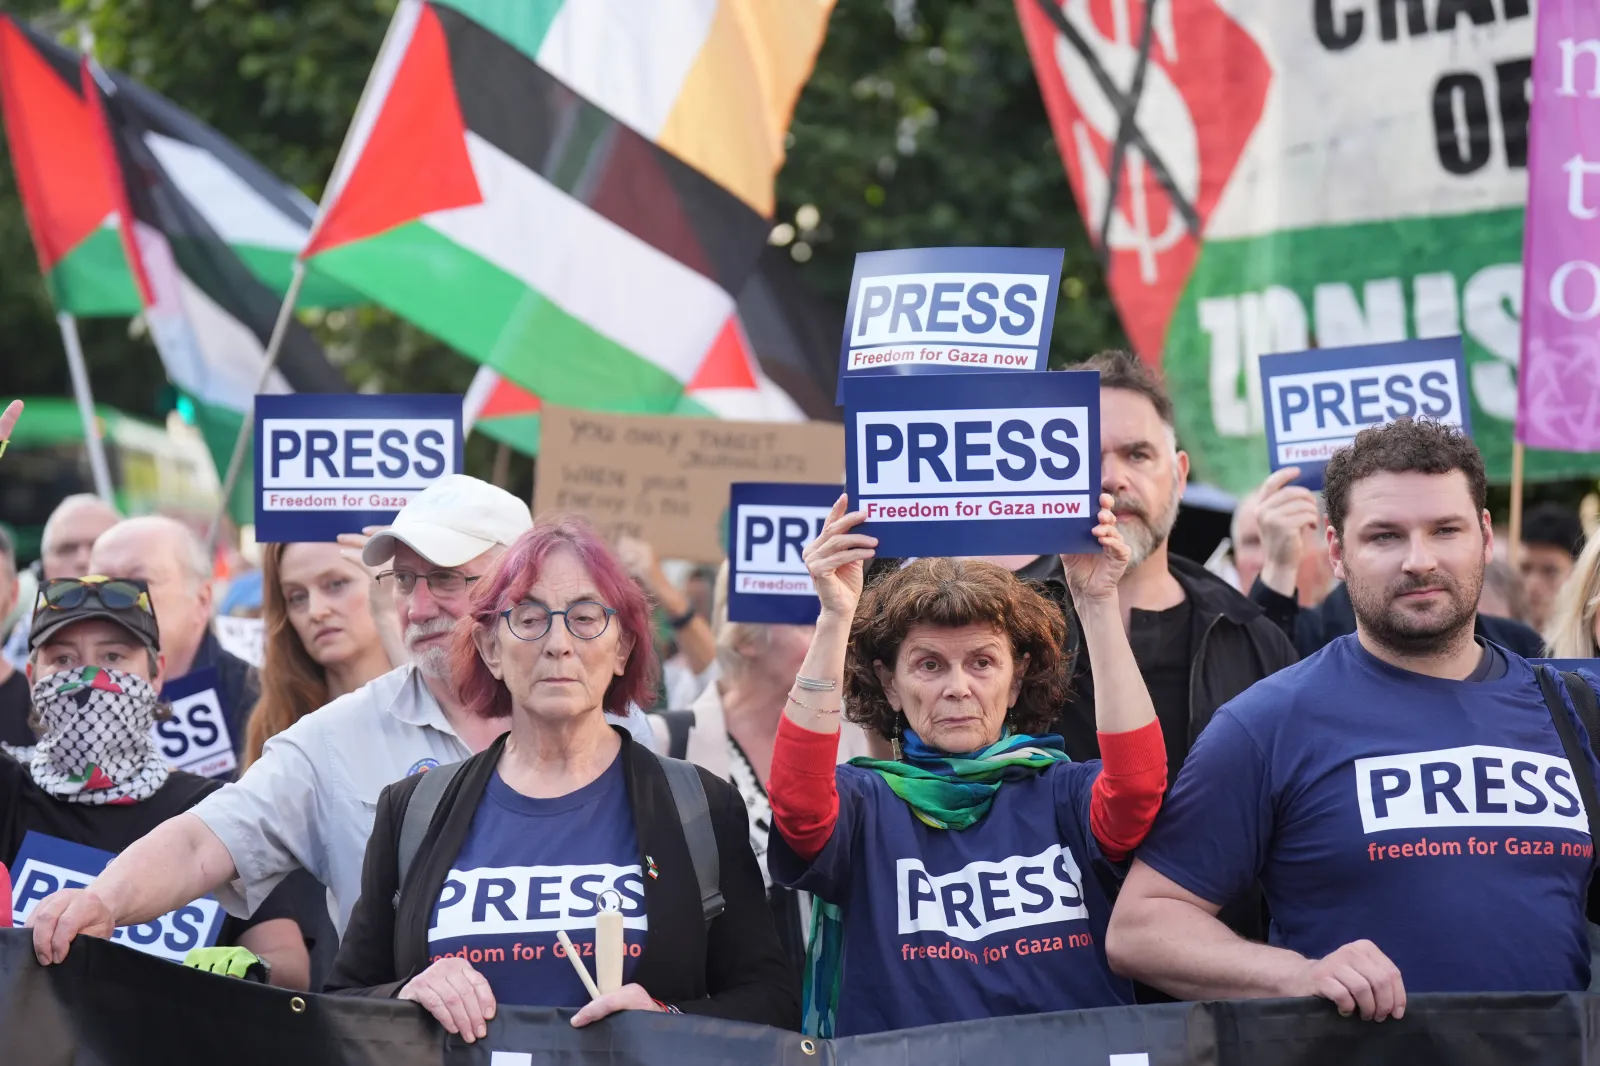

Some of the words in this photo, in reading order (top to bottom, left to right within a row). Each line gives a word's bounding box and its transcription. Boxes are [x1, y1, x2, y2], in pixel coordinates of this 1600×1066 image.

[857, 282, 1037, 336] PRESS
[853, 350, 914, 366] Freedom
[920, 348, 942, 361] for
[947, 349, 988, 364] Gaza
[994, 354, 1028, 366] now
[1278, 370, 1452, 432] PRESS
[270, 429, 445, 478] PRESS
[865, 418, 1081, 484] PRESS
[1285, 444, 1339, 459] Freedo
[270, 495, 336, 507] Freedom
[342, 495, 364, 507] for
[369, 495, 407, 507] Gaza
[867, 502, 949, 518] Freedom
[955, 502, 982, 517] for
[988, 501, 1035, 516] Gaza
[1042, 501, 1081, 514] now
[743, 577, 807, 590] Freedom
[1370, 757, 1581, 819] PRESS
[1368, 838, 1461, 861] freedom
[1468, 837, 1498, 855] for
[1505, 838, 1554, 855] Gaza
[1561, 842, 1593, 858] now
[14, 870, 204, 952] PSS
[429, 872, 647, 928] PRESS
[908, 854, 1083, 930] PRESS
[512, 943, 545, 961] for
[902, 942, 978, 964] freedom
[983, 945, 1009, 964] for
[1015, 934, 1063, 956] Gaza
[1068, 933, 1093, 948] no
